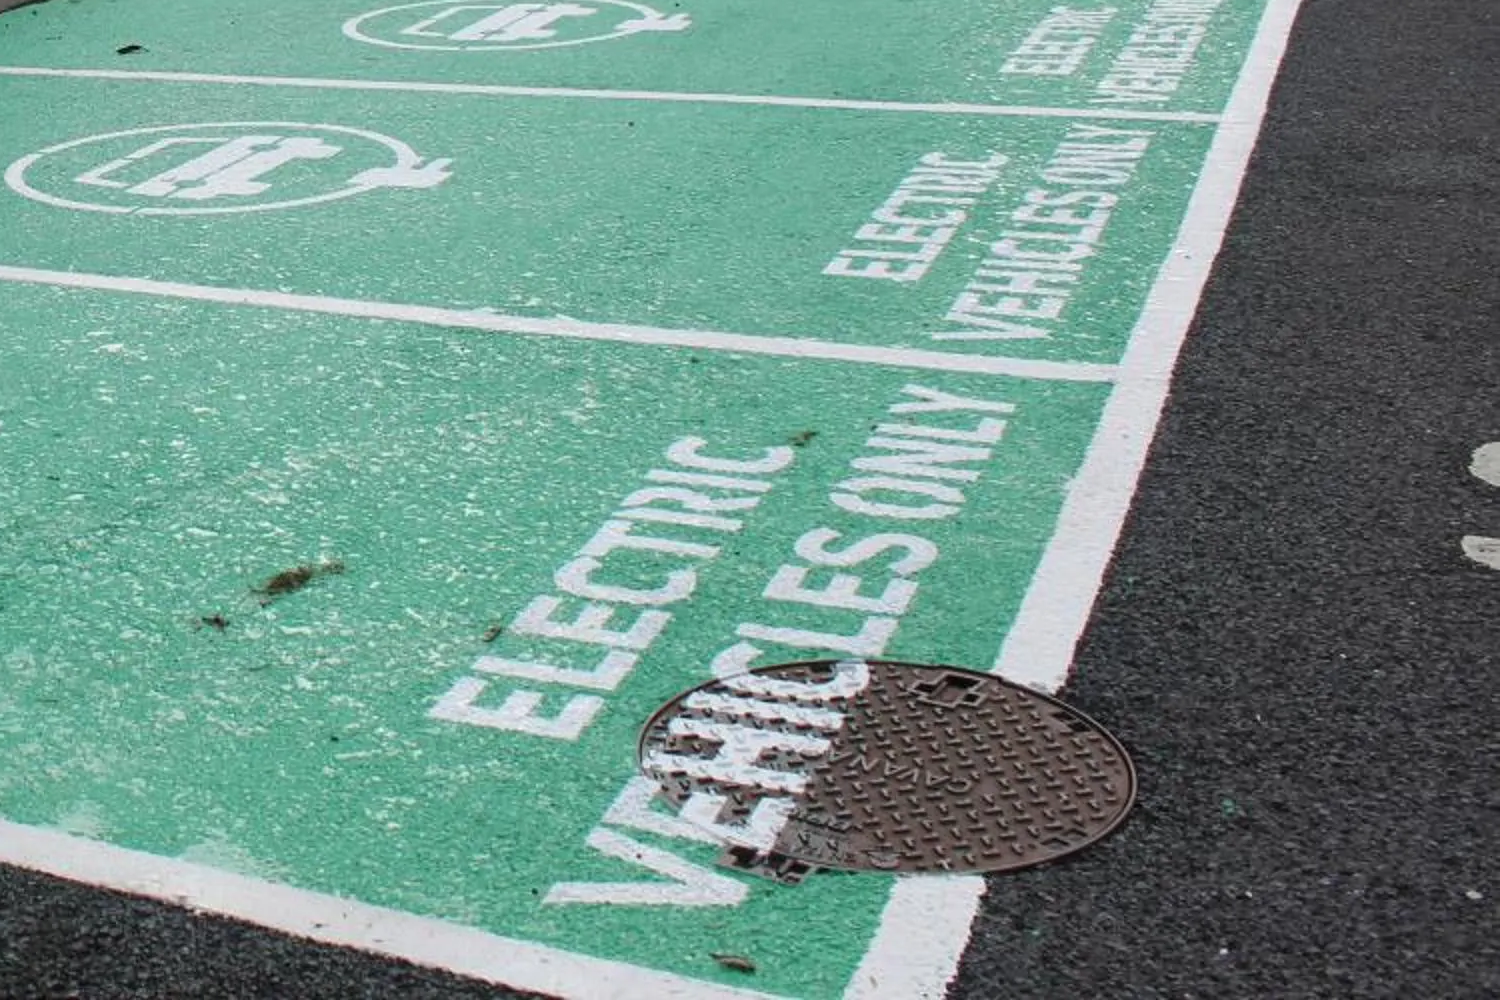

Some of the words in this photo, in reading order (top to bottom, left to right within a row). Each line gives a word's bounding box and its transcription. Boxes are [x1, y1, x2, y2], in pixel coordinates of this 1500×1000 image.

[820, 151, 1009, 283] ELECTRIC
[931, 188, 1118, 340] VEHICLES
[1041, 122, 1157, 185] ONLY
[426, 435, 793, 741] ELECTRIC
[542, 526, 938, 905] VEHICLES
[830, 383, 1017, 520] ONLY
